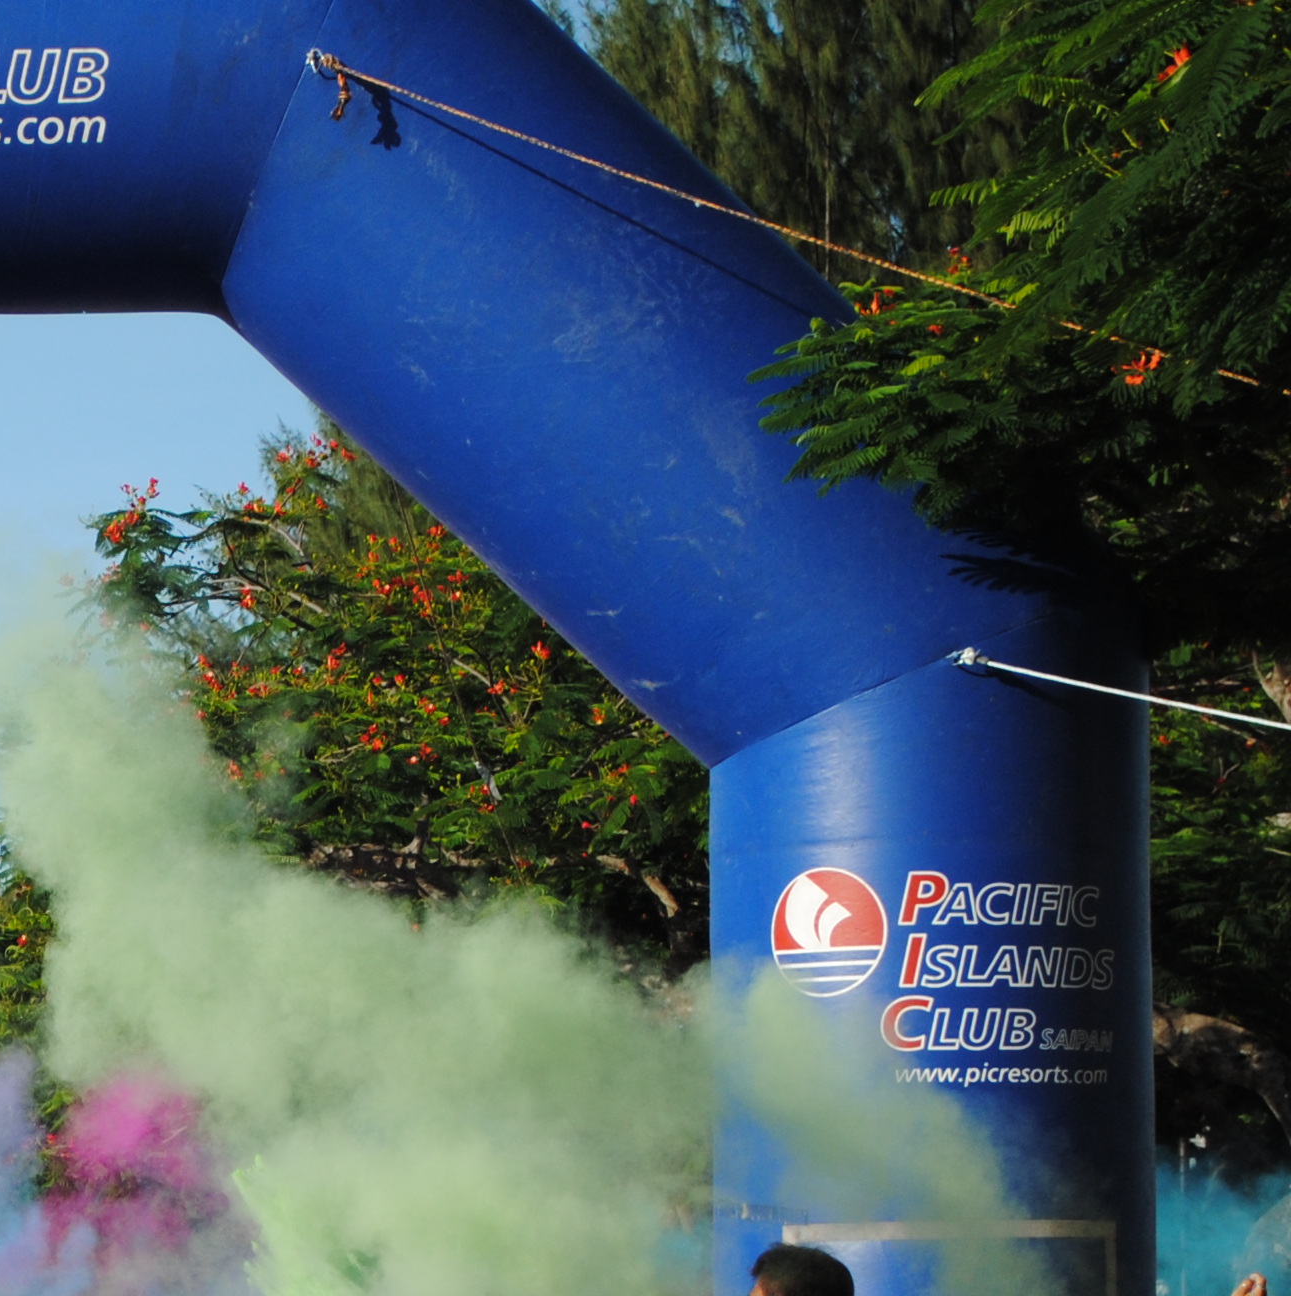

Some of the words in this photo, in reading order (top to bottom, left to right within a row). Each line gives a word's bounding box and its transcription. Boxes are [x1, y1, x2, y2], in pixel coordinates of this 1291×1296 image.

[898, 871, 1100, 927] PACIFIC
[899, 933, 1115, 990] ISLANDS
[880, 995, 1037, 1051] CLUB
[1039, 1027, 1113, 1052] SAIPAN
[895, 1062, 1107, 1087] www.picresorts.com
